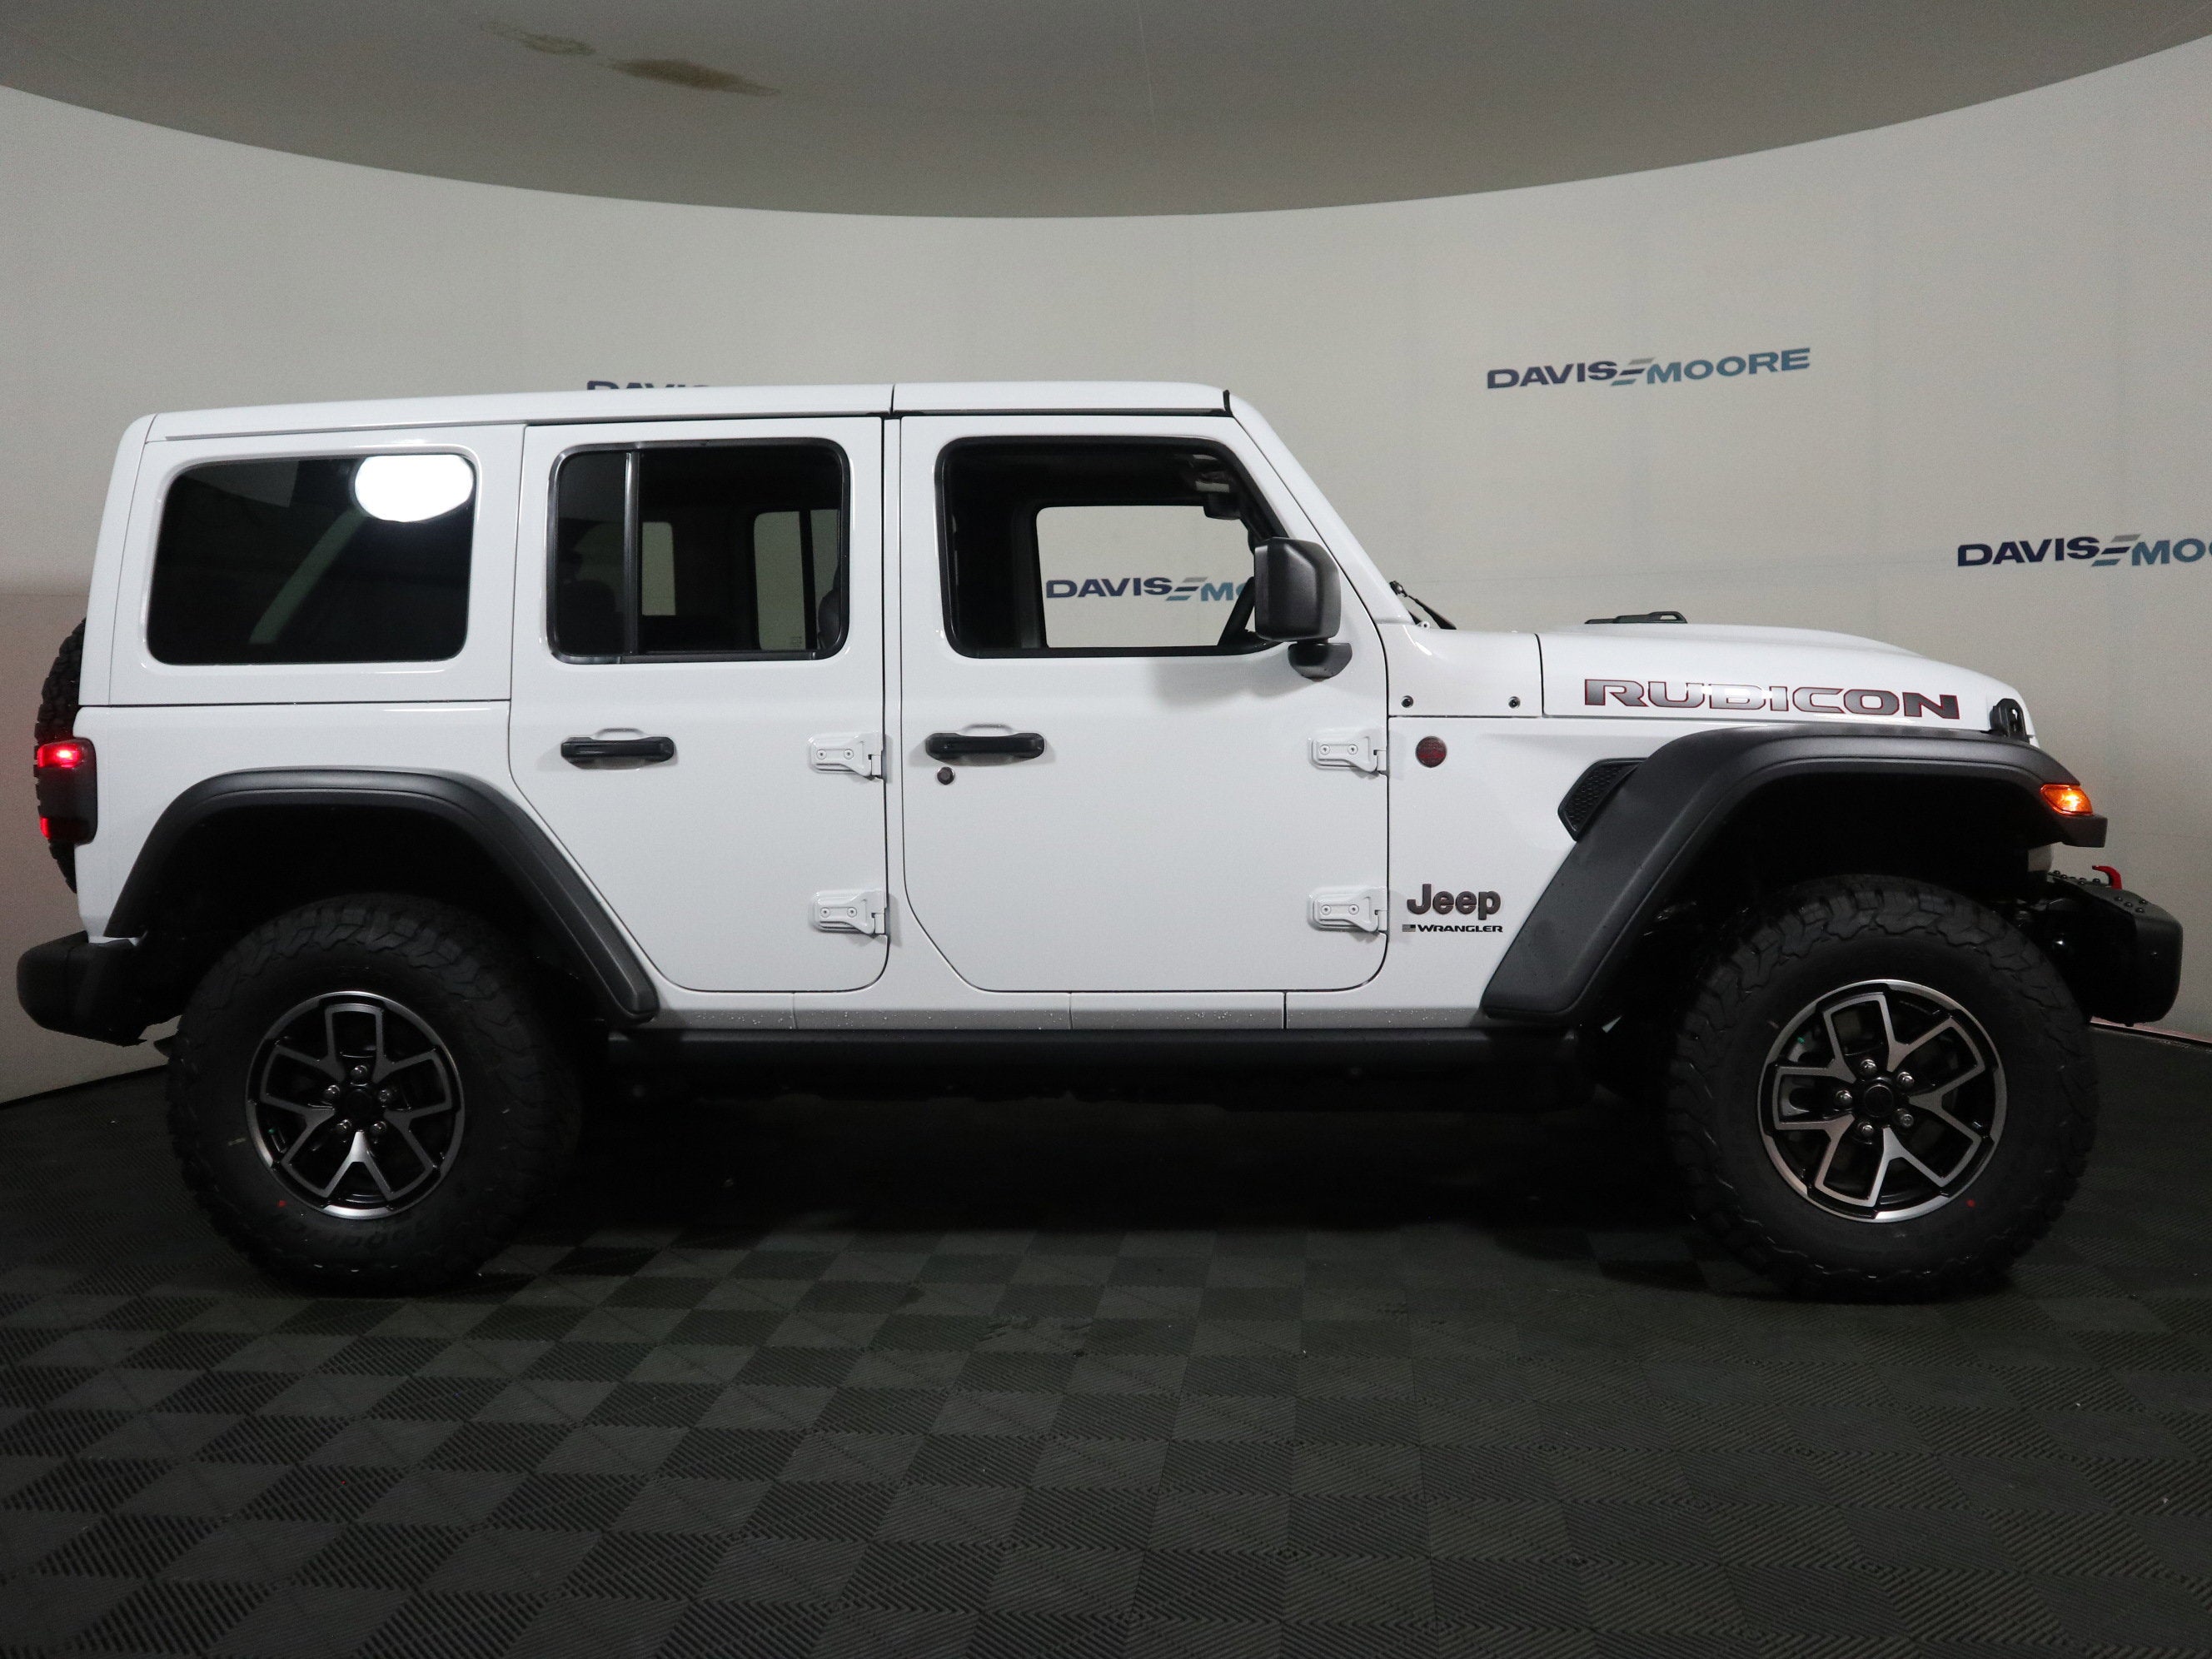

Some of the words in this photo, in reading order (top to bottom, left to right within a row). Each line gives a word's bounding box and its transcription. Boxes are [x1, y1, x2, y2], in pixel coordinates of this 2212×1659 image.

[1487, 361, 1618, 389] DAVIS
[1646, 347, 1811, 385] MOORE
[1957, 536, 2100, 567] DAVIS
[2131, 538, 2212, 566] MO
[1045, 576, 1173, 598] DAVIS
[1583, 678, 1960, 720] RUBICON
[1406, 883, 1502, 920] Jeep
[1417, 924, 1504, 933] WRANGLER
